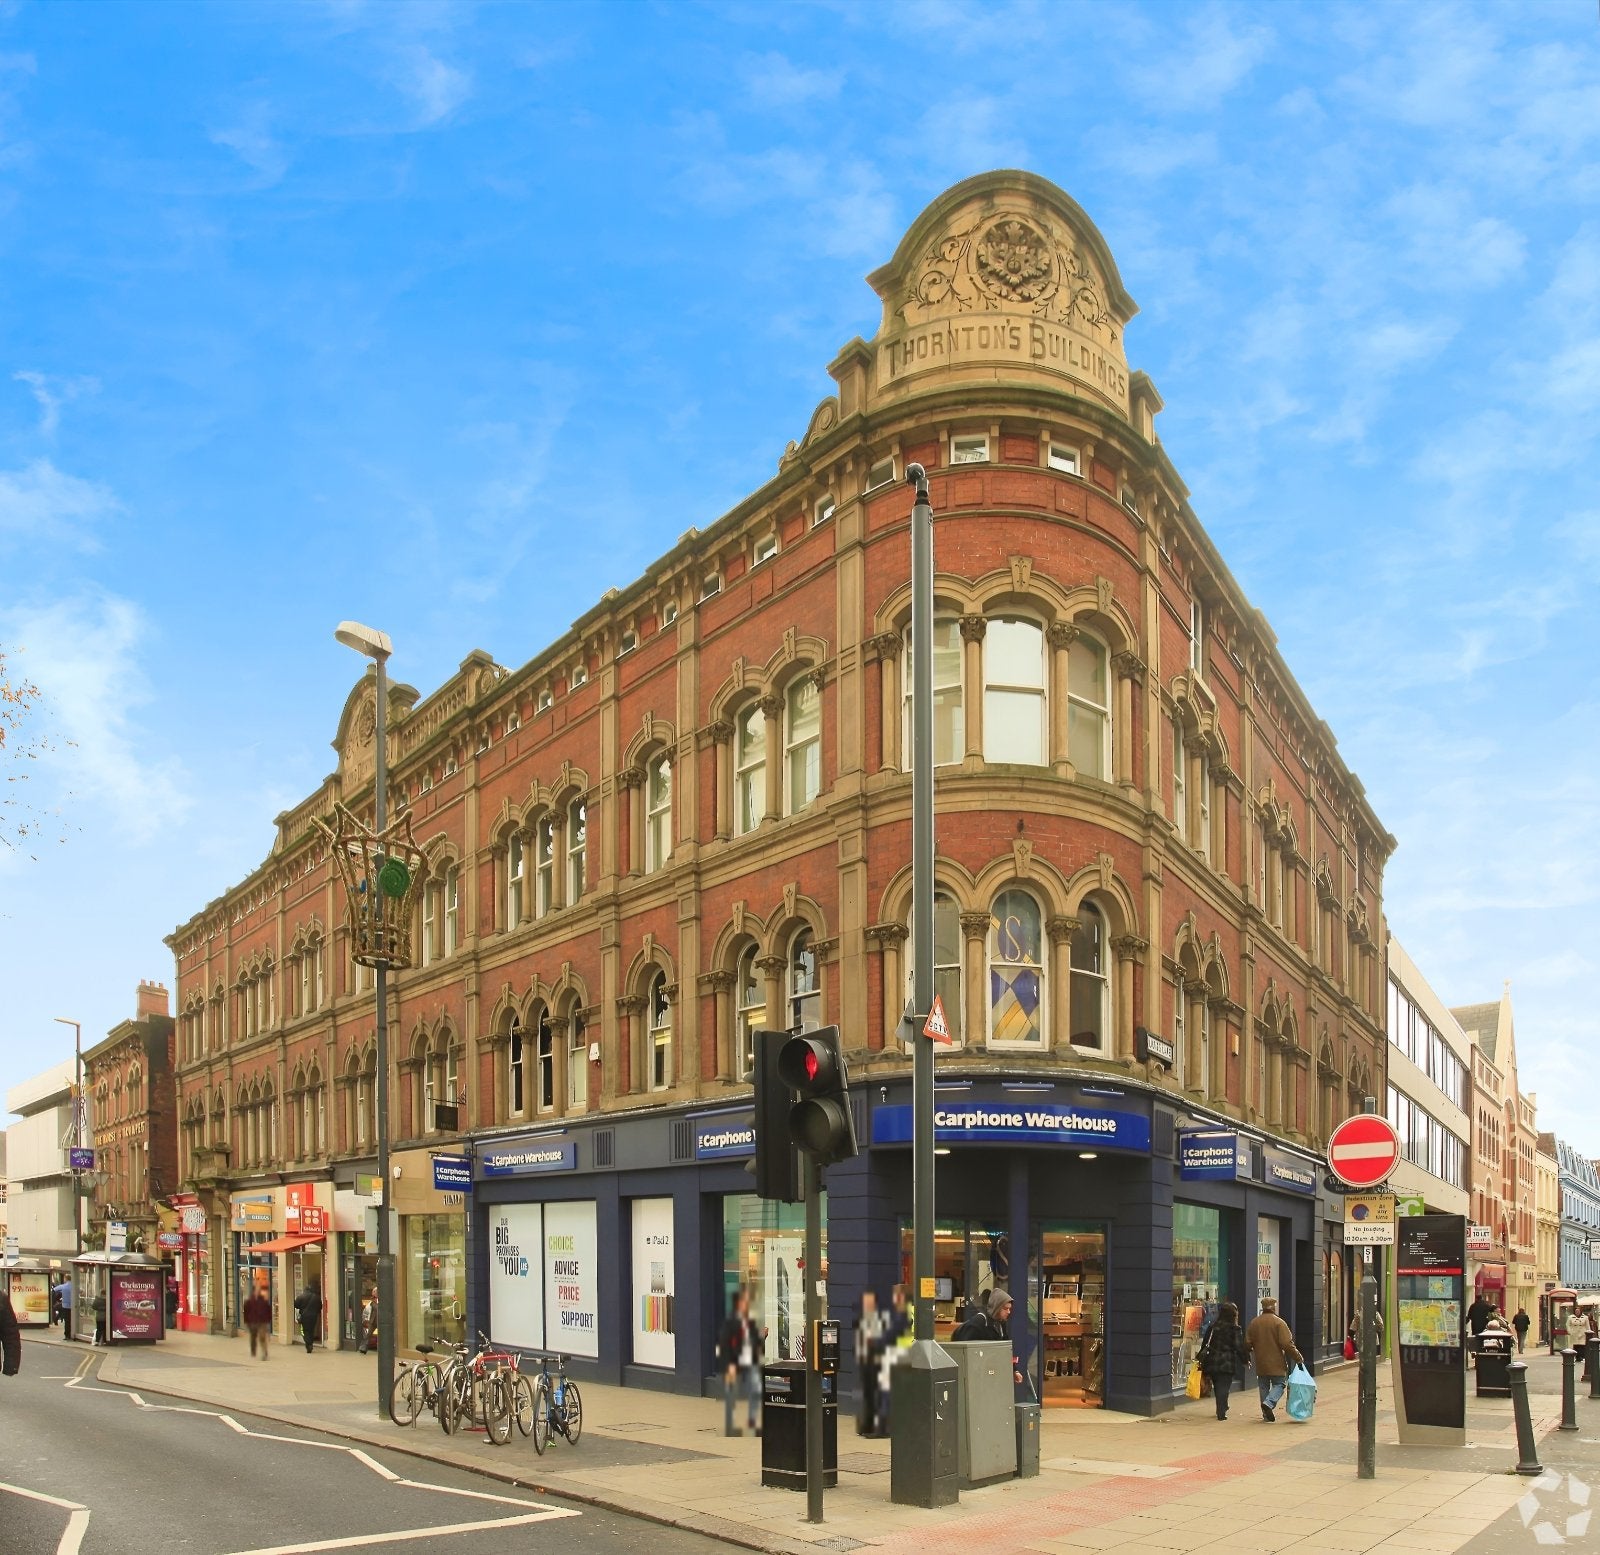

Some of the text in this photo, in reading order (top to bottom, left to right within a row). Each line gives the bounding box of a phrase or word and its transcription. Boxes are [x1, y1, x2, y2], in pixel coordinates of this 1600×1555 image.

[934, 1110, 1117, 1132] Carphone Warehouse
[703, 1131, 752, 1148] Carphone
[495, 1154, 525, 1167] Carphone
[525, 1150, 562, 1163] Warehouse
[1188, 1147, 1234, 1158] Carphone
[1183, 1157, 1234, 1167] Warehouse
[437, 1173, 470, 1183] Warehouse
[440, 1167, 470, 1176] Carphone
[495, 1226, 509, 1245] BIG
[548, 1236, 574, 1250] CHOICE
[504, 1257, 519, 1275] YOU
[554, 1260, 579, 1276] ADVICE
[558, 1285, 580, 1301] PRICE
[561, 1311, 594, 1328] SUPPORT
